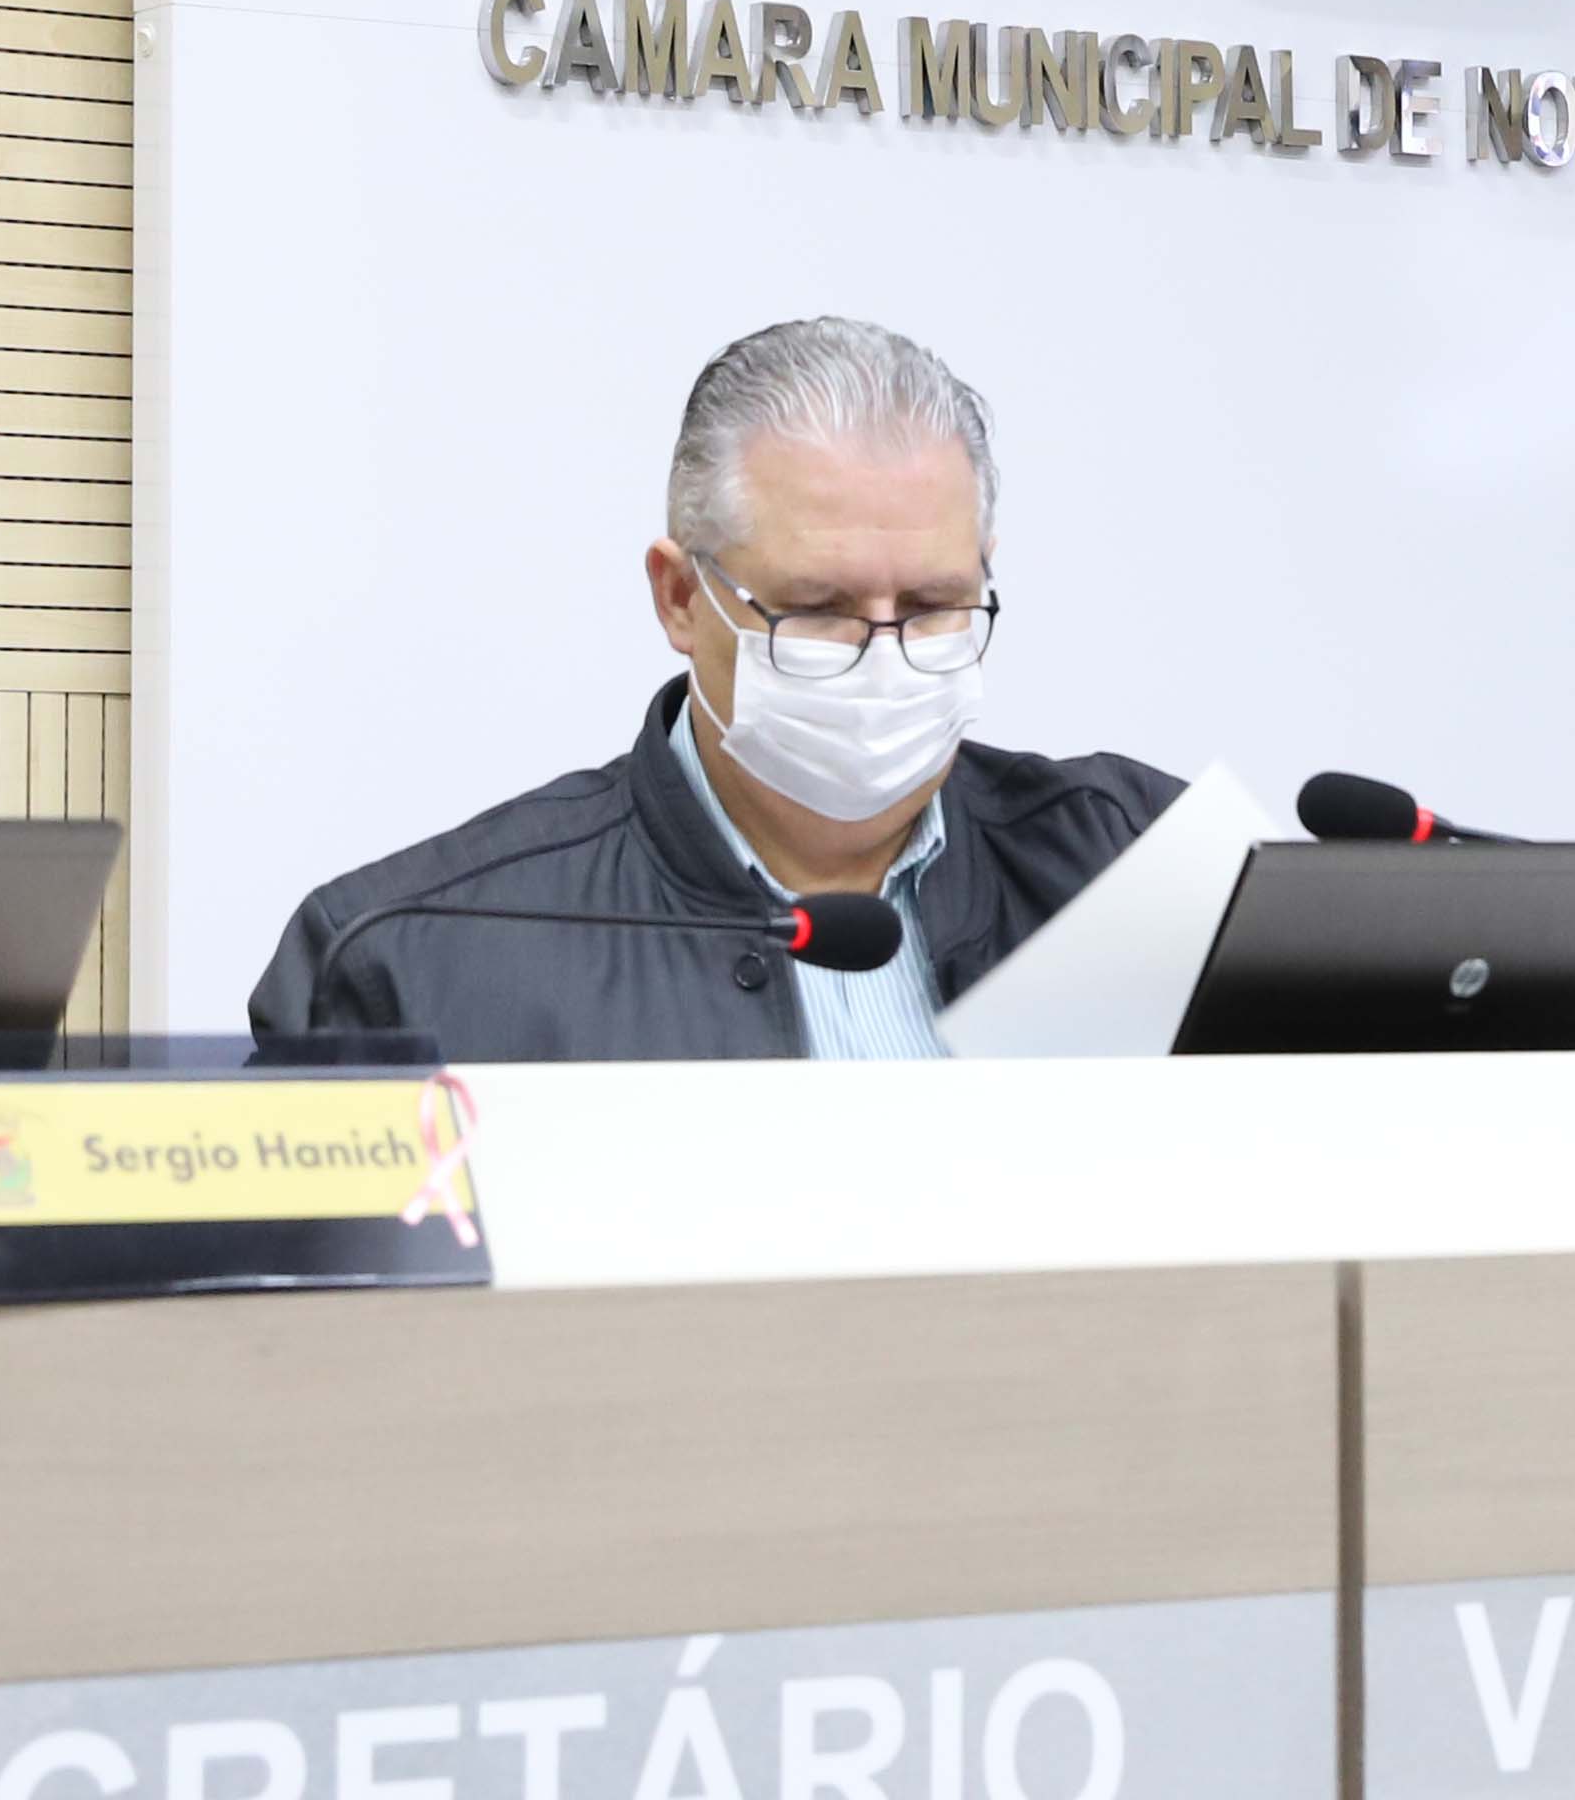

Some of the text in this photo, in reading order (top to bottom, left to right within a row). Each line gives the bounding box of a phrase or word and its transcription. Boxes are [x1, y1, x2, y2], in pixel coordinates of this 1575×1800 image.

[897, 15, 1323, 147] MUNICIPAL
[1336, 53, 1443, 159] DE
[82, 1130, 417, 1184] Sergio Hanich
